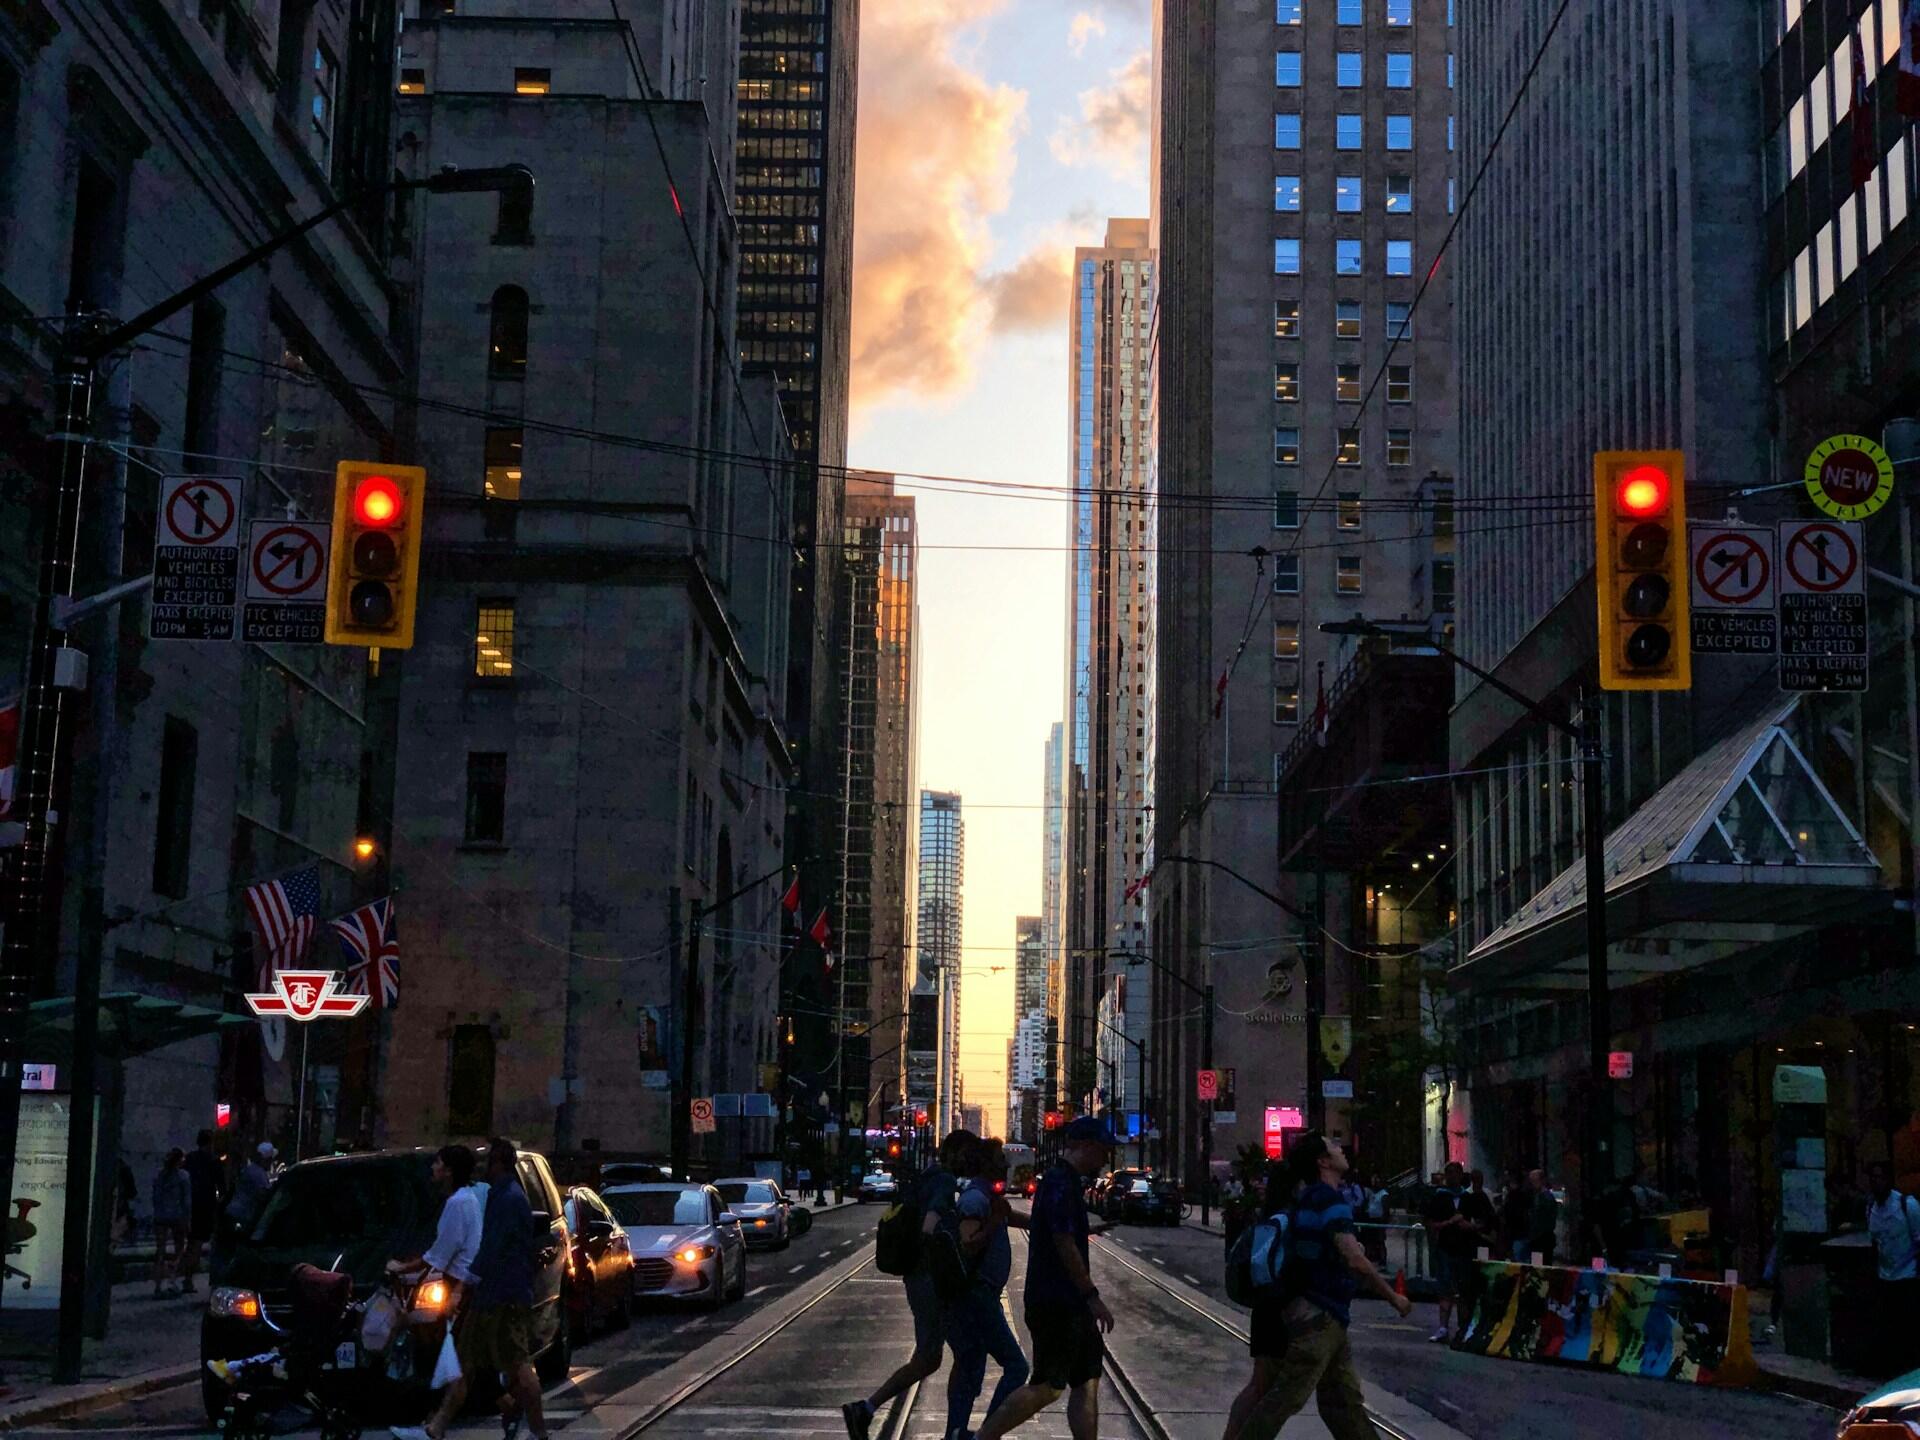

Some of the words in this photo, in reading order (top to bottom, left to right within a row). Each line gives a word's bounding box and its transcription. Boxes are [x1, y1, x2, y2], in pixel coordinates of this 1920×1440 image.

[1824, 464, 1874, 492] NEW
[159, 547, 235, 561] AUTHORIZED
[168, 561, 225, 575] VEHICLES
[156, 576, 178, 589] AND
[184, 576, 235, 590] BICYCLES
[163, 590, 225, 604] EXCEPTED
[1783, 594, 1863, 608] AUTHORIZED
[153, 606, 181, 619] TAXIS
[186, 607, 234, 620] EXCEPTED
[246, 608, 267, 621] TTC
[272, 608, 325, 621] VEHICLES
[1793, 609, 1853, 623] VEHICLES
[248, 624, 320, 638] EXCEPTED
[1693, 617, 1716, 632] TTC
[1722, 618, 1776, 632] VEHICLES
[1783, 624, 1806, 638] AND
[1812, 624, 1864, 638] BICYCLES
[1695, 634, 1772, 649] EXCEPTED
[1792, 639, 1856, 653] EXCEPTED
[1782, 656, 1810, 670] TAXIS
[1816, 657, 1867, 670] EXCEPTED
